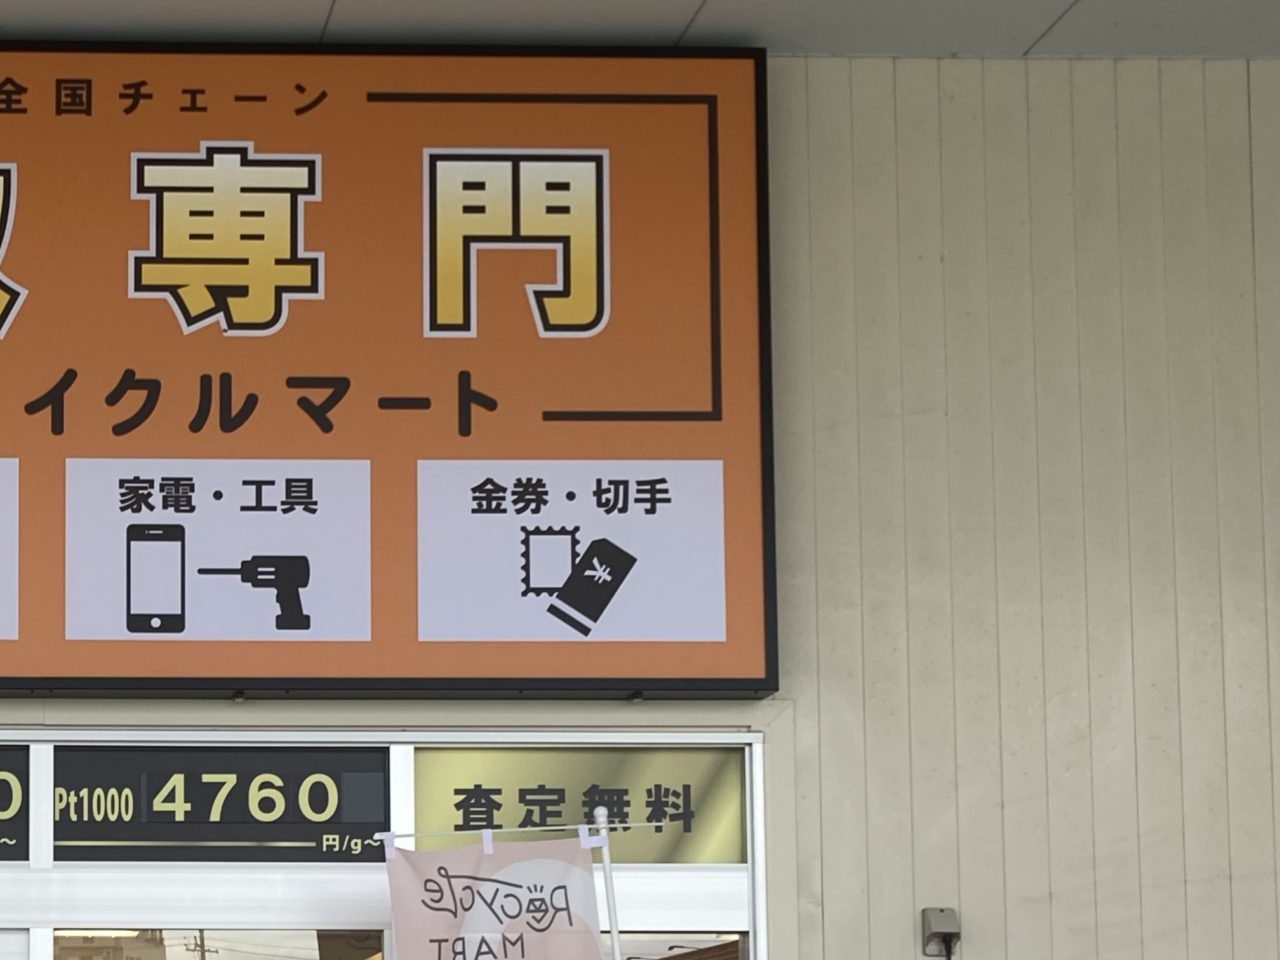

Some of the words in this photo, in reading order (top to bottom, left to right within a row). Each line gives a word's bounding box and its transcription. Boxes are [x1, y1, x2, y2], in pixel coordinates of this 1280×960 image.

[118, 476, 319, 515] 家電・工具
[470, 477, 673, 515] 金券・切手
[54, 783, 134, 823] Pt1000
[152, 773, 340, 823] 4760
[453, 783, 696, 834] 査定無料
